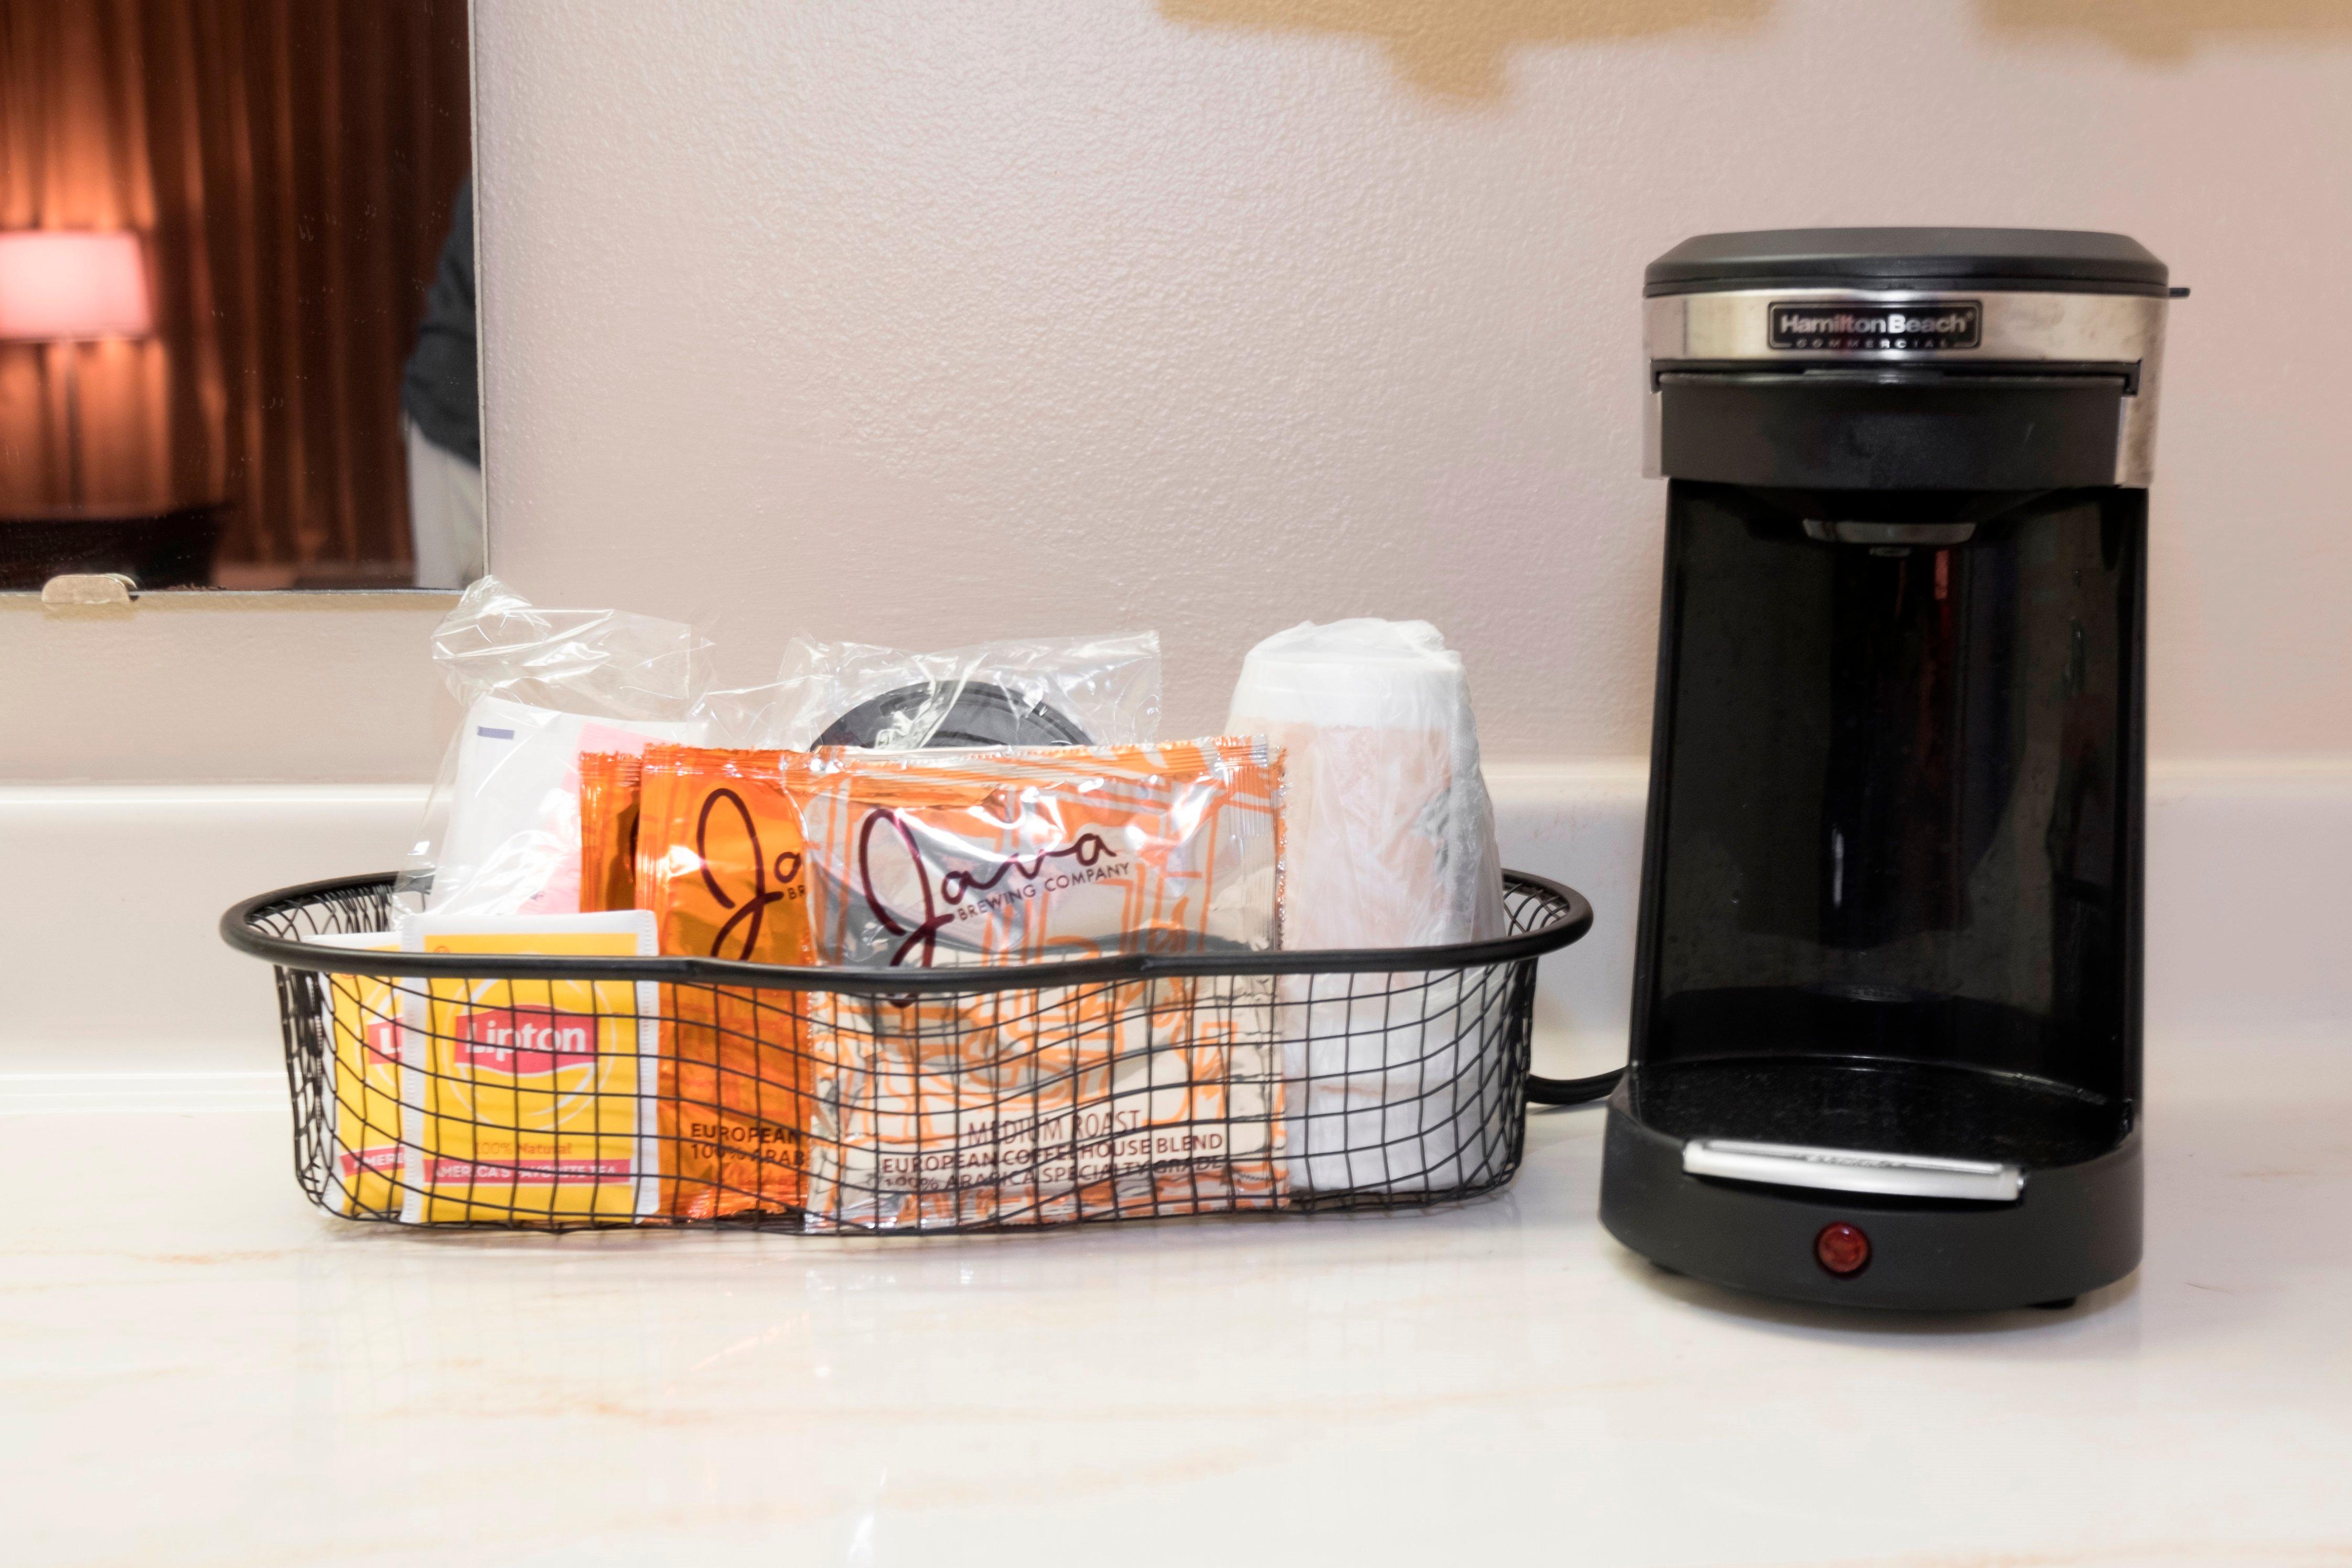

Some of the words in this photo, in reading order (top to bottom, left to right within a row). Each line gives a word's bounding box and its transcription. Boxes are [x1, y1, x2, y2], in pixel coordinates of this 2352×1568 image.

[1796, 339, 1948, 348] COMMERCIAL
[958, 884, 1036, 921] BREWING
[1044, 862, 1129, 892] COMPANY
[859, 808, 1116, 1007] Java
[465, 1020, 586, 1062] Lipton
[515, 1142, 572, 1154] Natual
[691, 1123, 800, 1144] EUROPEAN
[883, 1152, 996, 1173] EUROPEAN
[1157, 1134, 1222, 1154] BLEND
[1043, 1160, 1152, 1183] SPECIATY
